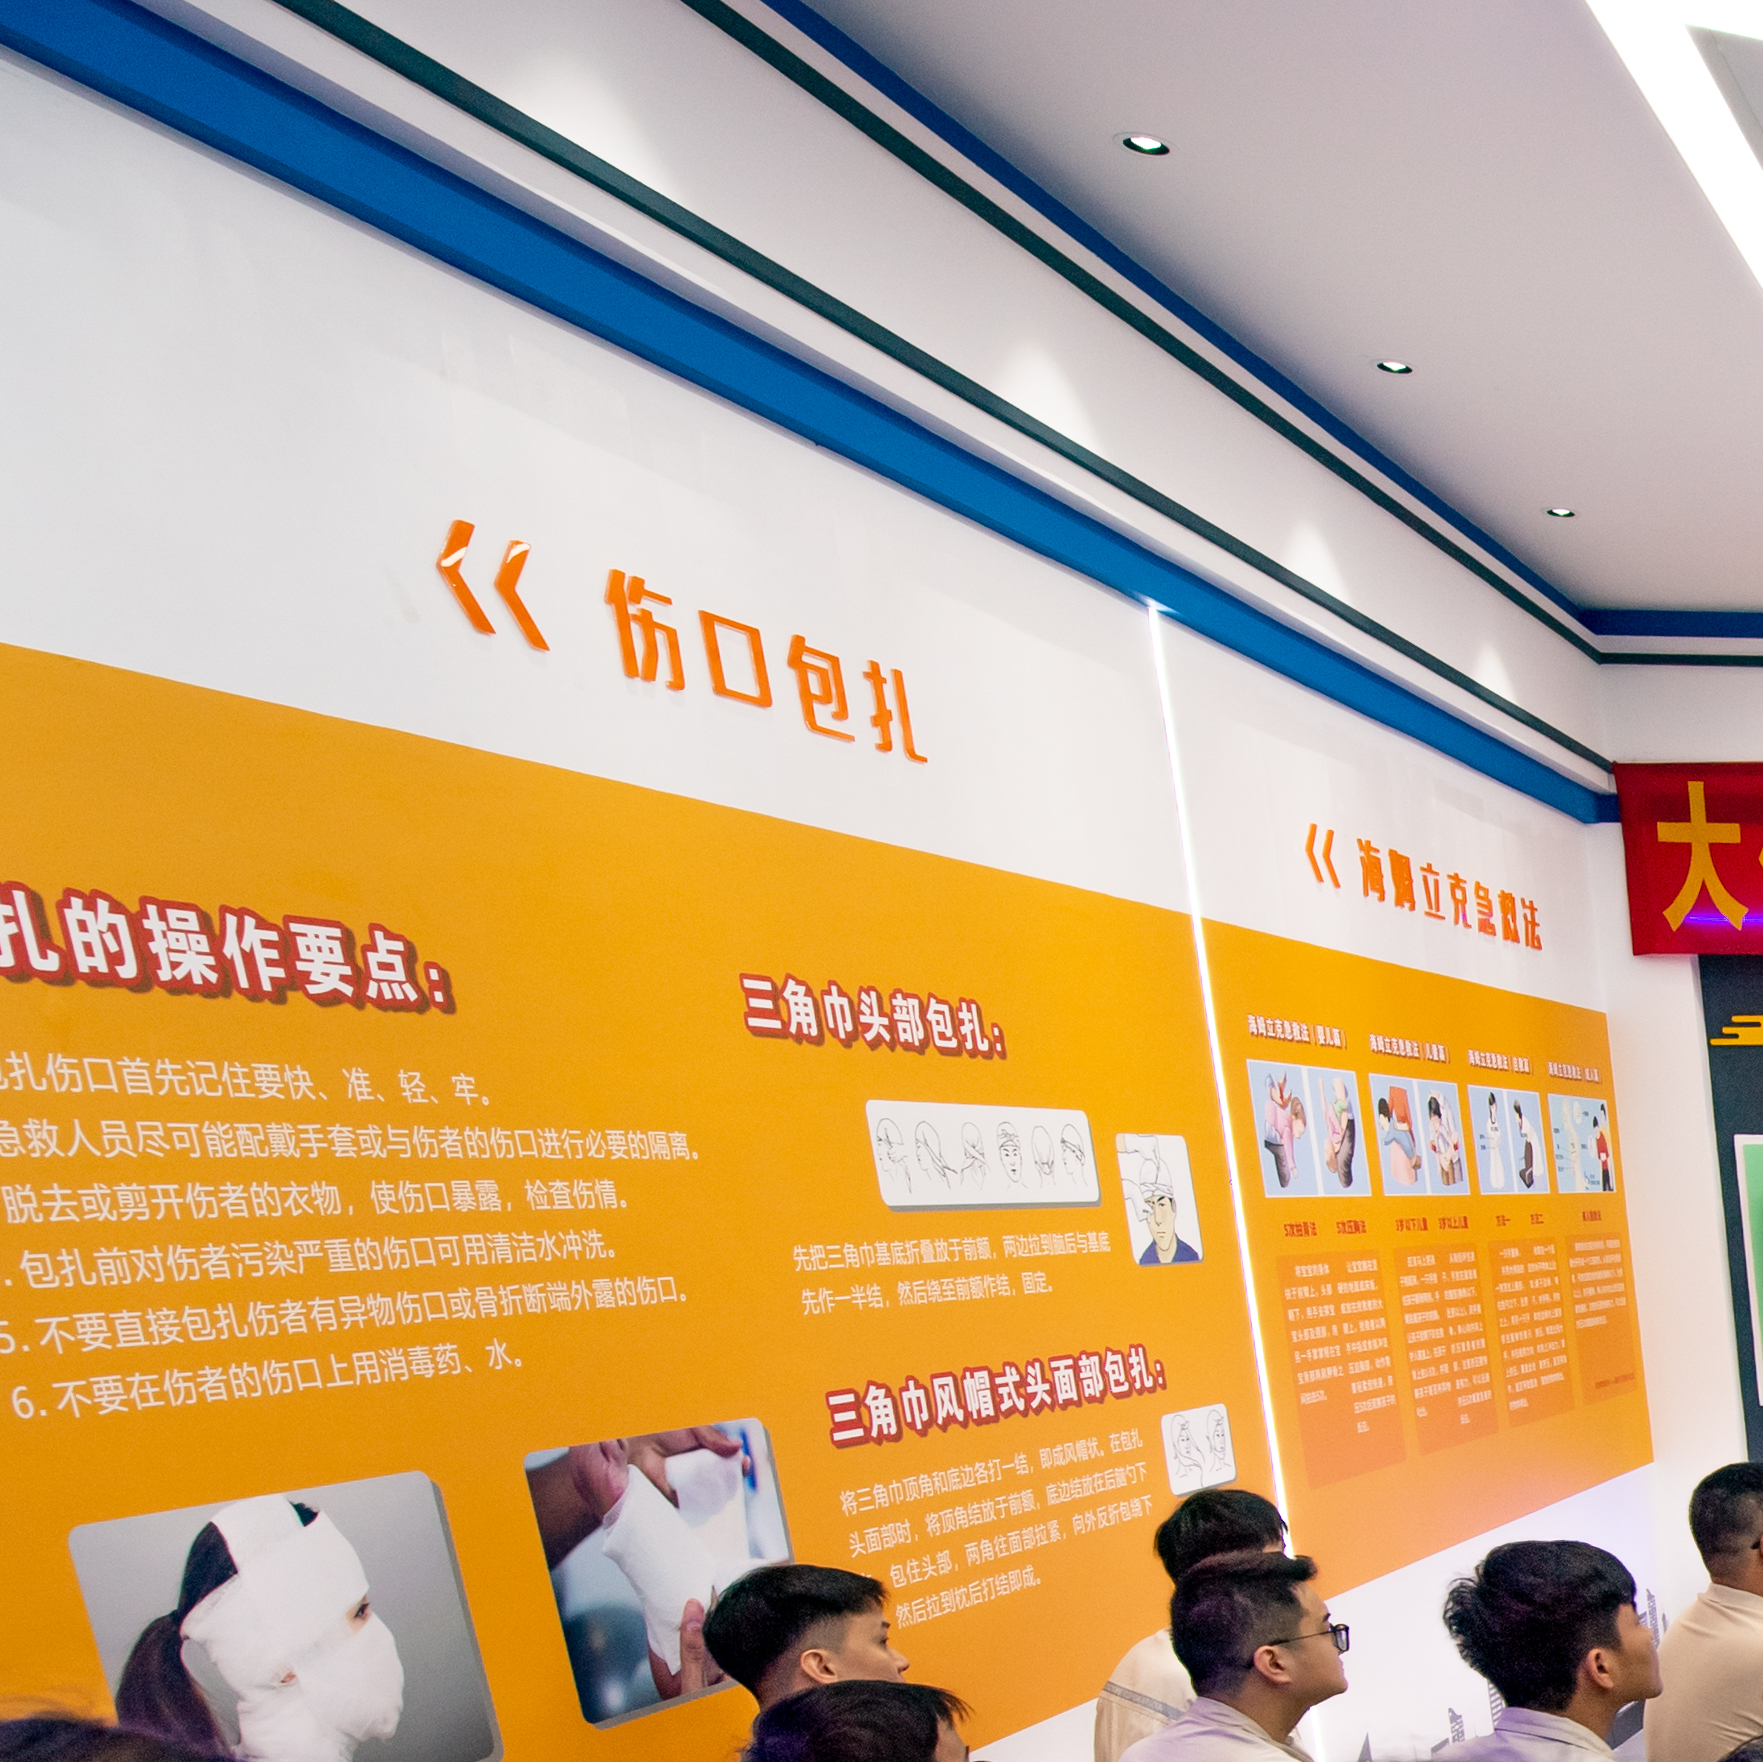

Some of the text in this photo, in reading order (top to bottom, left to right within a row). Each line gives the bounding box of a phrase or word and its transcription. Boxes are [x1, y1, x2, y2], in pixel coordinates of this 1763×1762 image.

[603, 567, 929, 764] 伤口包扎
[1356, 837, 1543, 951] 海姆立克急救法
[740, 976, 1003, 1054] 三角巾头部包扎：
[6, 1178, 628, 1224] 脱去或剪开伤者的衣物，使伤口暴露，检查伤情。
[826, 1346, 1166, 1442] 三角巾风帽式头面部包扎：
[858, 1495, 1154, 1589] 包住头部，两角往面部拉紧，向外反折包绕下
[895, 1565, 1042, 1630] 然后拉到枕后打结即成。
